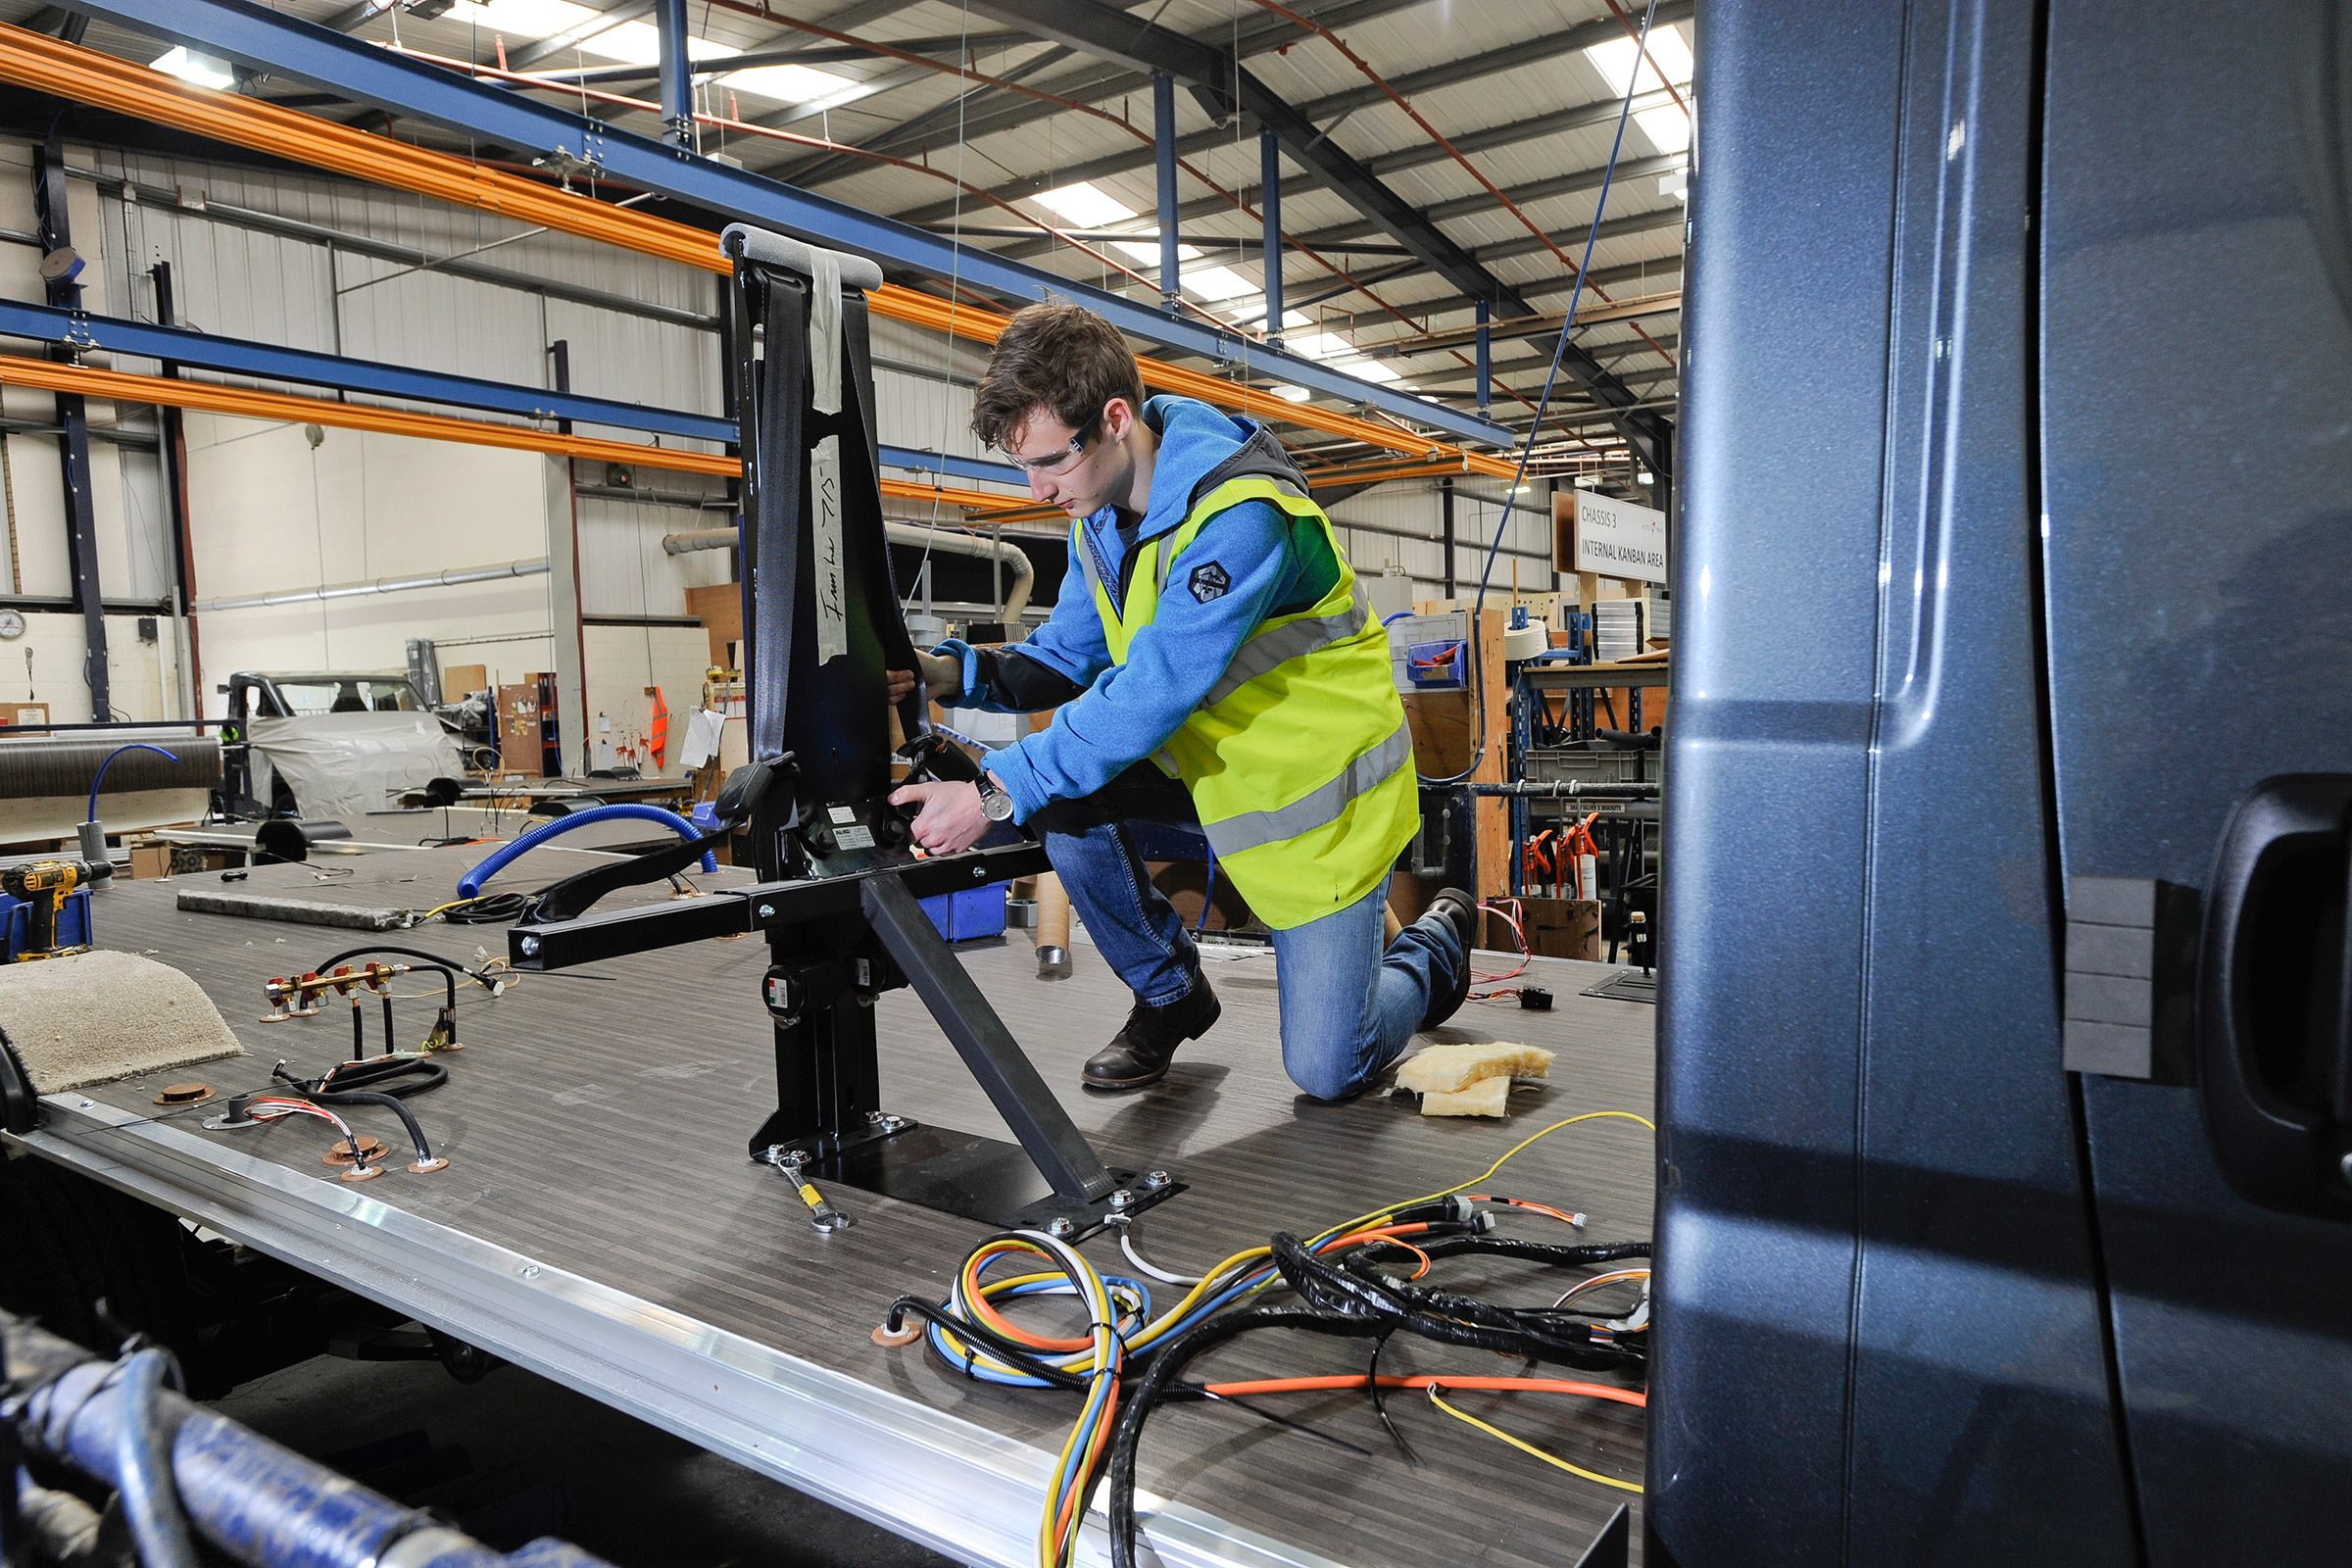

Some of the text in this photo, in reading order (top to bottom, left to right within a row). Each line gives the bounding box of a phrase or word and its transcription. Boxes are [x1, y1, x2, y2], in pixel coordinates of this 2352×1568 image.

[1582, 506, 1617, 528] CHASSIS 3
[1582, 538, 1664, 568] INTERNAL KANBAN AREA
